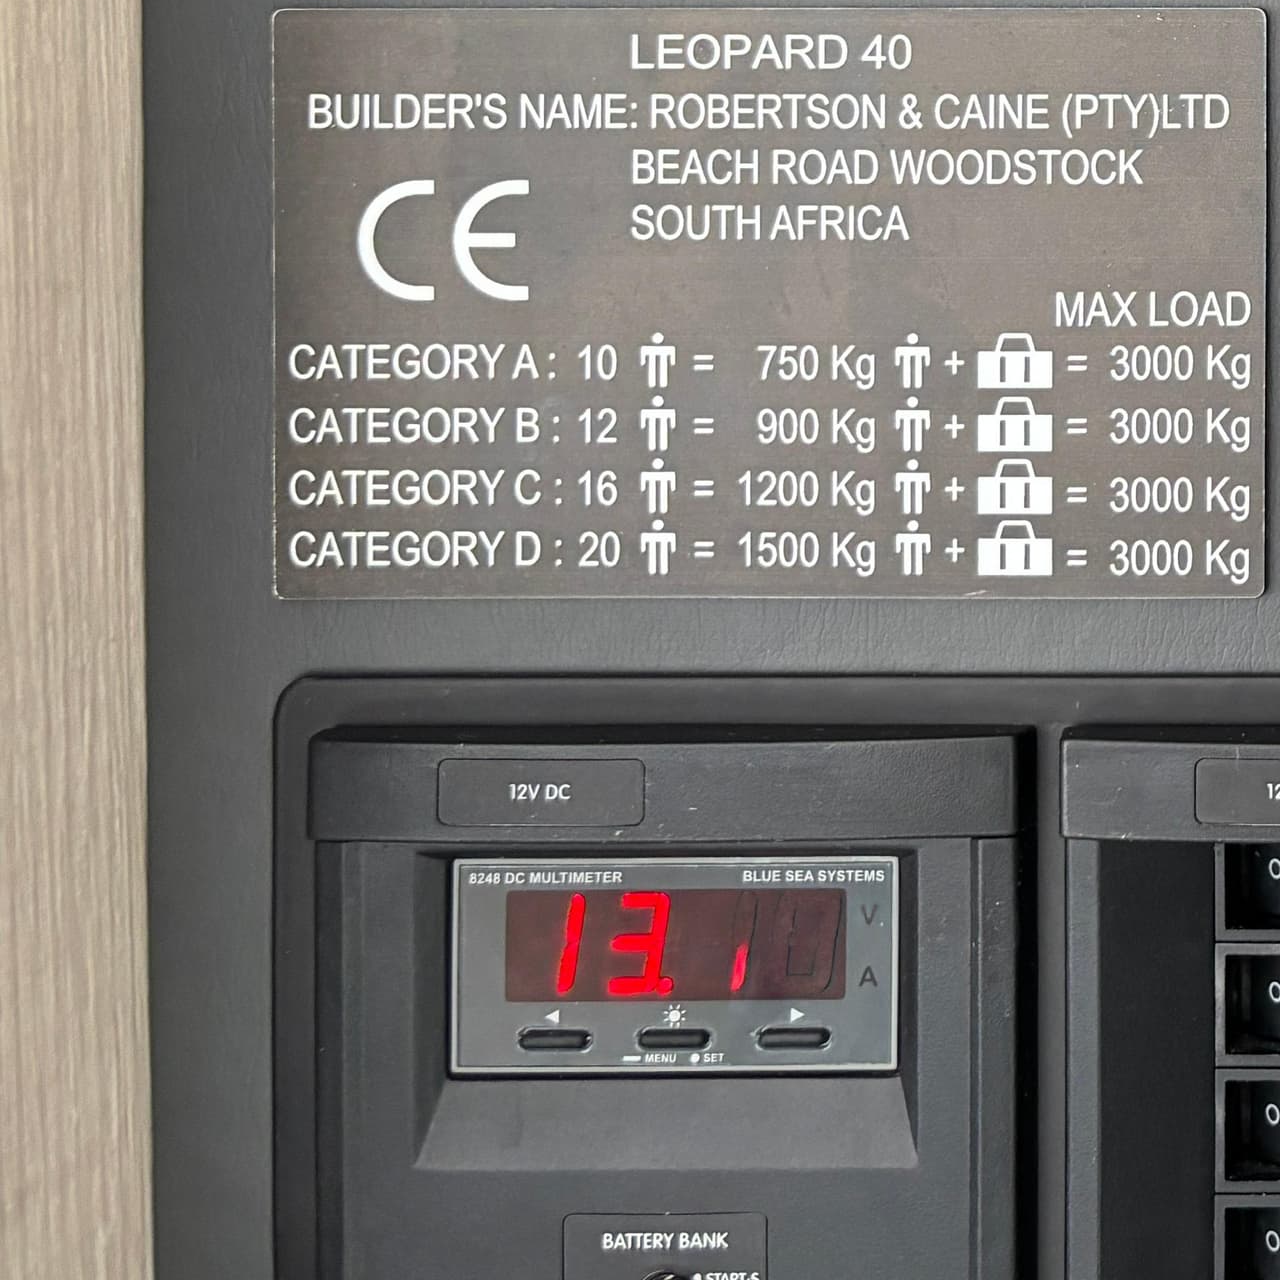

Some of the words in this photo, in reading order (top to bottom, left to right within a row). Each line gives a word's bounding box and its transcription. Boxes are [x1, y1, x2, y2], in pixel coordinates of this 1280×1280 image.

[632, 34, 847, 69] LEOPARD
[861, 34, 911, 69] 40
[310, 93, 507, 129] BUILDER'S
[521, 94, 637, 129] NAME:
[651, 93, 885, 129] ROBERTSON
[899, 94, 923, 129] &
[934, 94, 1049, 129] CAINE
[1062, 93, 1229, 138] (PTY)LTD
[633, 149, 758, 184] BEACH
[773, 149, 878, 184] ROAD
[890, 149, 1143, 185] WOODSTOCK
[632, 205, 760, 240] SOUTH
[770, 205, 909, 240] AFRICA
[1056, 292, 1137, 327] MAX
[1150, 291, 1250, 327] LOAD
[290, 344, 505, 380] CATEGORY
[578, 344, 617, 380] 10
[757, 345, 818, 380] 750
[832, 345, 874, 390] Kg
[1110, 345, 1193, 381] 3000
[1207, 345, 1250, 389] Kg
[510, 784, 540, 800] 12V
[545, 784, 570, 800] DC
[469, 873, 500, 884] 8248
[505, 873, 525, 883] DC
[530, 872, 622, 883] MULTIMETER
[743, 870, 780, 882] BLUE
[786, 870, 814, 881] SEA
[818, 870, 884, 881] SYSTEMS
[645, 1054, 676, 1062] MENU
[703, 1053, 725, 1064] SET
[603, 1233, 674, 1249] BATTERY
[679, 1232, 728, 1249] BANK
